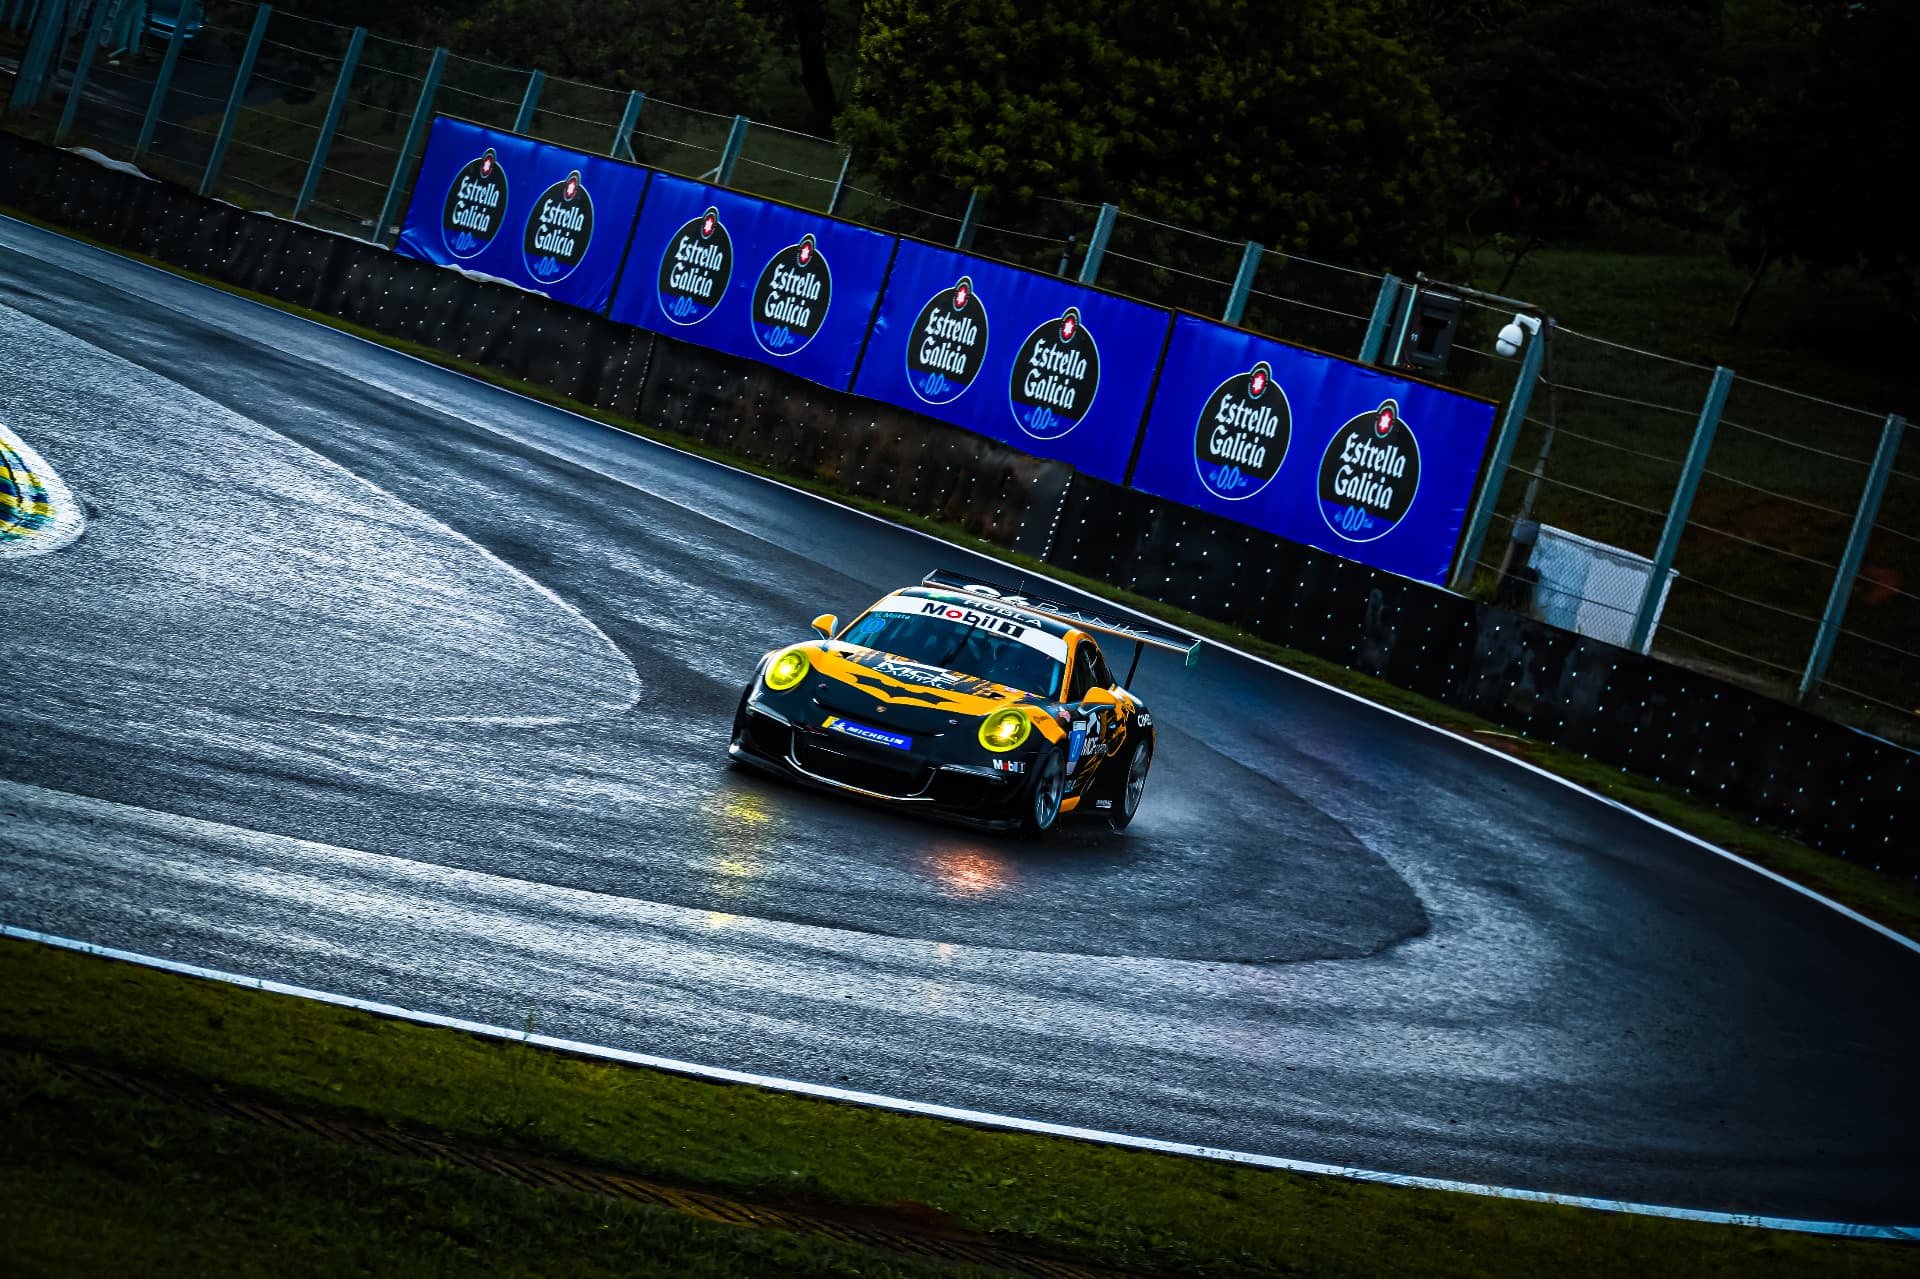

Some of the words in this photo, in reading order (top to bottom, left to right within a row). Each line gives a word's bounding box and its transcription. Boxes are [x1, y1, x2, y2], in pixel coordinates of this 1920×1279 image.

[457, 177, 499, 206] Estrella
[452, 200, 490, 232] Galicia
[539, 200, 584, 231] Estrella
[535, 225, 574, 256] Galicia
[675, 235, 724, 270] Estrella
[670, 263, 713, 298] Galicia
[769, 263, 821, 300] Estrella
[764, 293, 810, 327] Galicia
[926, 308, 977, 347] Estrella
[920, 337, 967, 375] Galicia
[1029, 338, 1087, 380] Estrella
[1024, 368, 1076, 409] Galicia
[1215, 393, 1279, 438] Estrella
[1210, 425, 1266, 468] Galicia
[1340, 432, 1406, 478] Estrella
[1335, 465, 1393, 510] Galicia
[921, 602, 998, 629] Mobil
[846, 726, 905, 745] MICHELIN
[992, 759, 1018, 773] Mobil
